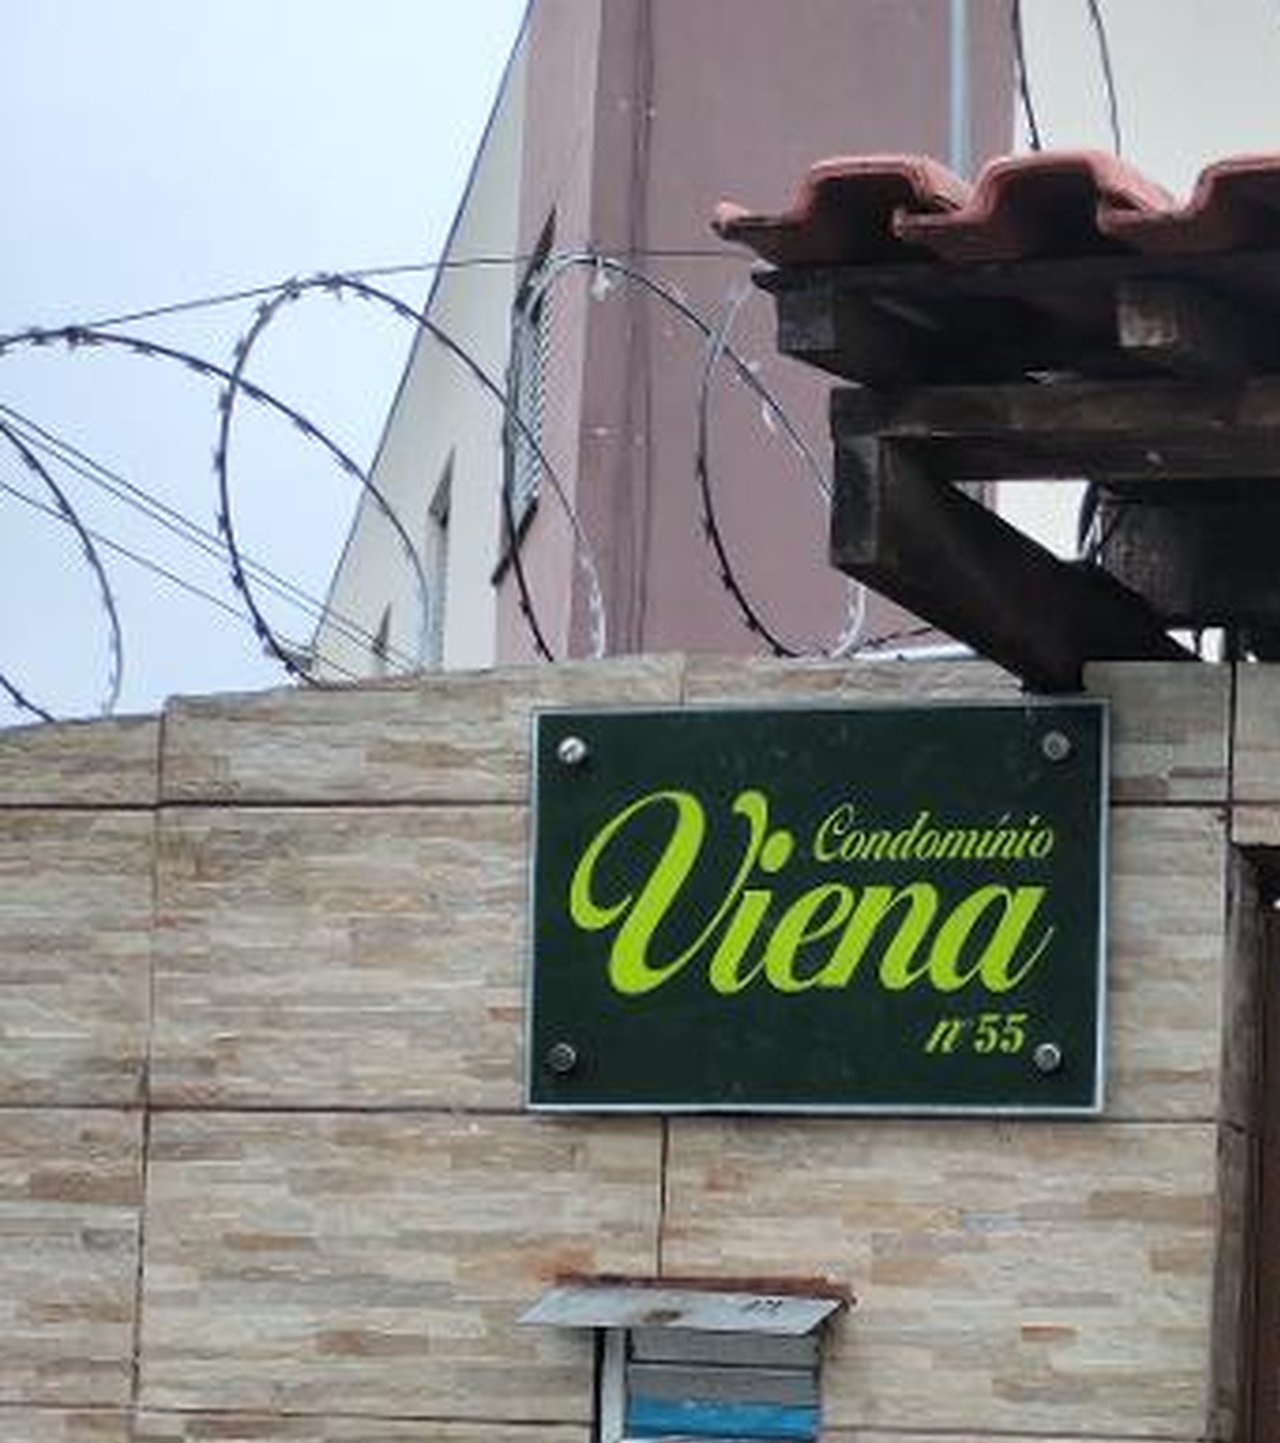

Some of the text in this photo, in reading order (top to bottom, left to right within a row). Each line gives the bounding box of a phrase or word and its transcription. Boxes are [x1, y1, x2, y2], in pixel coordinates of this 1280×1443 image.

[814, 802, 1054, 861] Condomínio
[569, 789, 1054, 995] Viena
[974, 1012, 1028, 1053] 55
